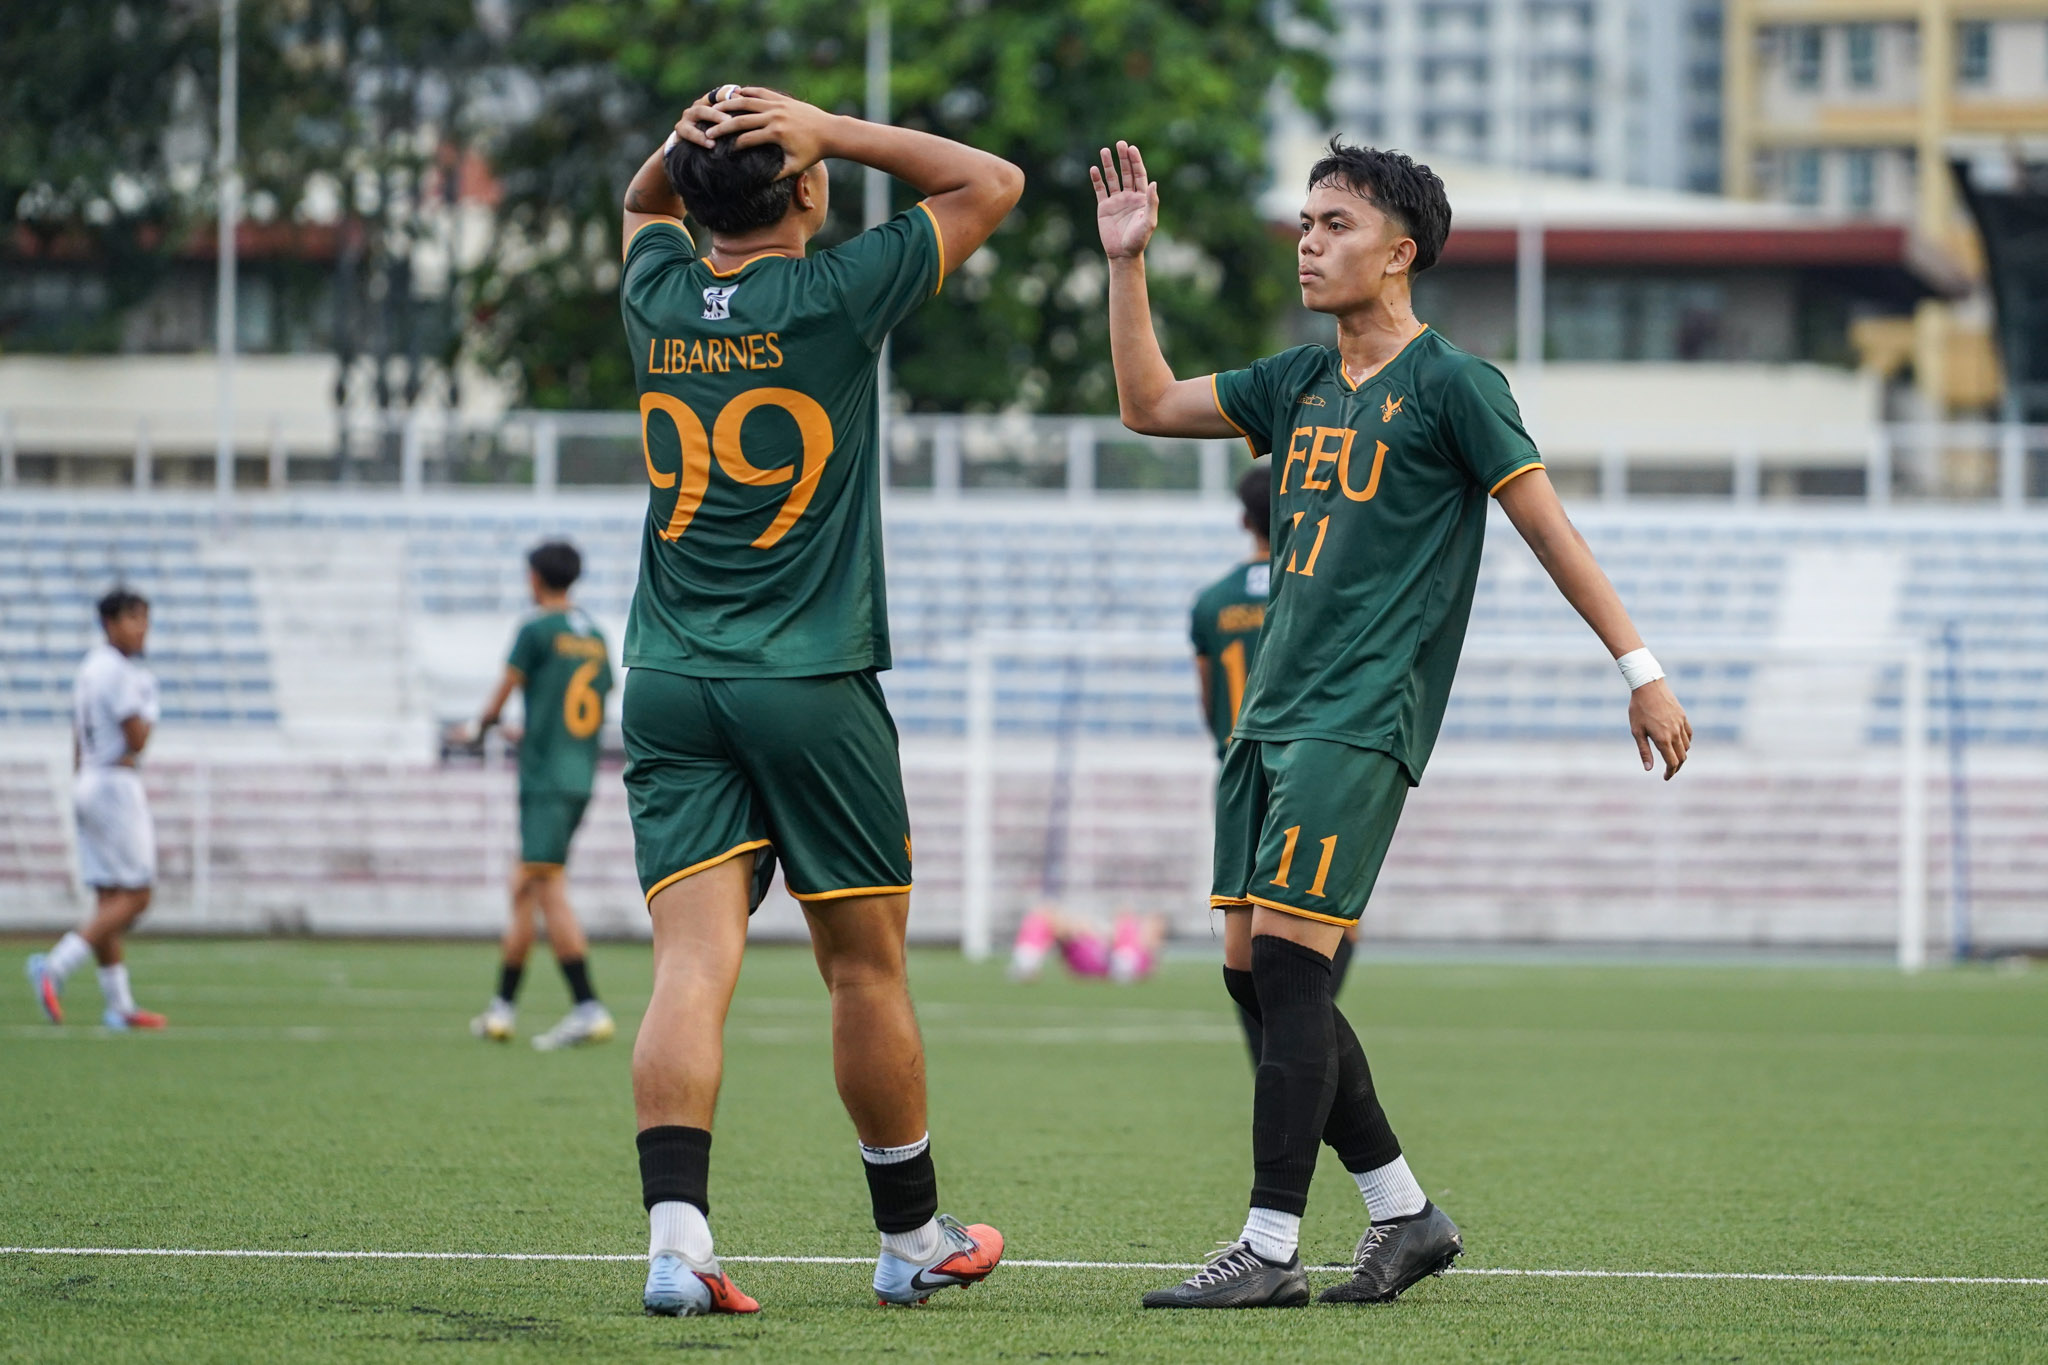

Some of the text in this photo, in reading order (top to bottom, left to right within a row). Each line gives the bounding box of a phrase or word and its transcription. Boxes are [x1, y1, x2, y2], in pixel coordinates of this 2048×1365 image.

[648, 332, 784, 374] LIBARNES
[640, 387, 834, 550] 99
[1279, 426, 1390, 502] FEU
[564, 660, 602, 740] 6
[1269, 825, 1339, 899] 11
